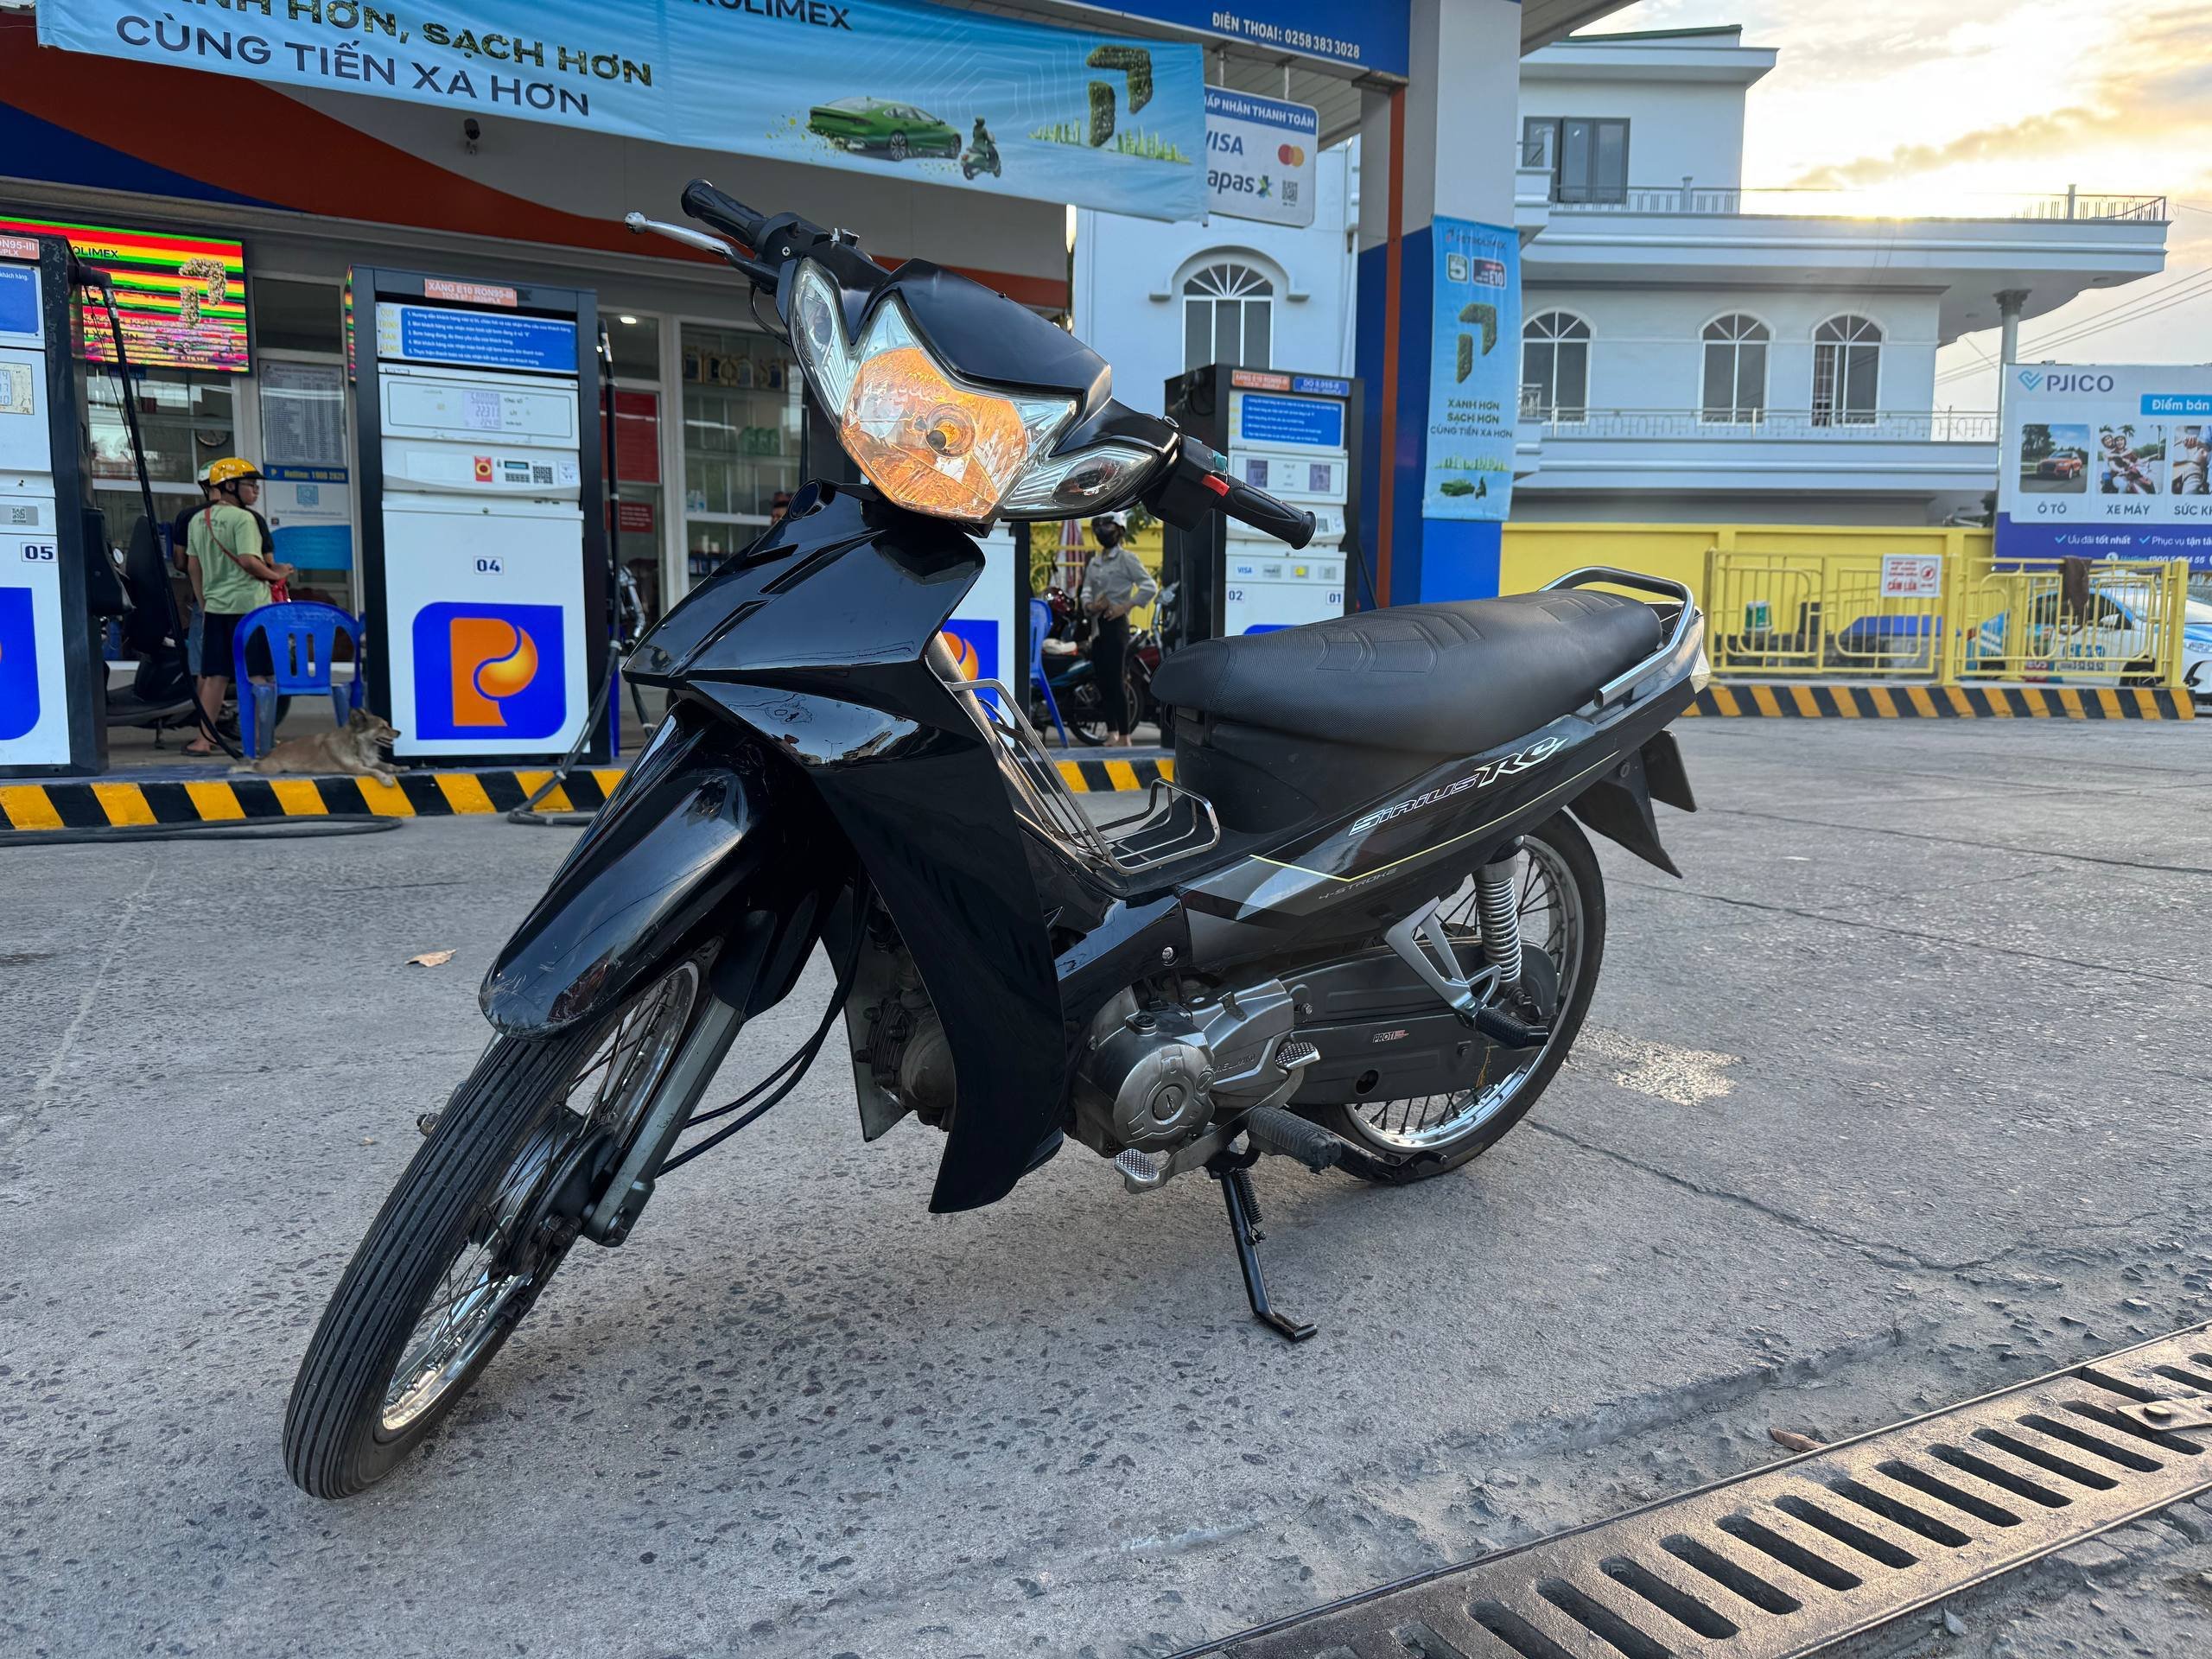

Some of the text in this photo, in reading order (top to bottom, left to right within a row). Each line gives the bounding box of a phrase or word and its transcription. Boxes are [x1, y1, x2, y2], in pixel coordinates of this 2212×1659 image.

[1211, 11, 1360, 59] ĐIỆN THOẠI: 0258 383 3028
[423, 22, 544, 67] SẠCH
[557, 45, 652, 86] HƠN
[117, 12, 589, 117] CÙNG TIẾN XA HƠN
[1222, 99, 1250, 116] NHẬN
[1252, 105, 1287, 123] THANH
[1287, 111, 1314, 129] TOÁN
[1489, 270, 1503, 286] E10
[2046, 374, 2114, 392] PJICO
[1447, 398, 1500, 410] XANH HƠN
[2152, 397, 2209, 410] Điểm bán
[1446, 413, 1499, 425] SẠCH HƠN
[2037, 501, 2067, 514] Ô TÔ
[2106, 502, 2151, 515] XE MÁY
[2173, 502, 2198, 516] SỨC
[2095, 534, 2108, 544] tốt
[2110, 534, 2131, 544] nhất
[2152, 537, 2174, 547] Phục
[2175, 538, 2184, 547] vụ
[2186, 536, 2201, 547] tận
[24, 545, 54, 560] 05
[476, 559, 500, 572] 04
[1228, 590, 1243, 601] 02
[1329, 593, 1341, 603] 01
[1349, 737, 1569, 836] SIRIUS RC
[1318, 867, 1398, 899] 4-STROKE
